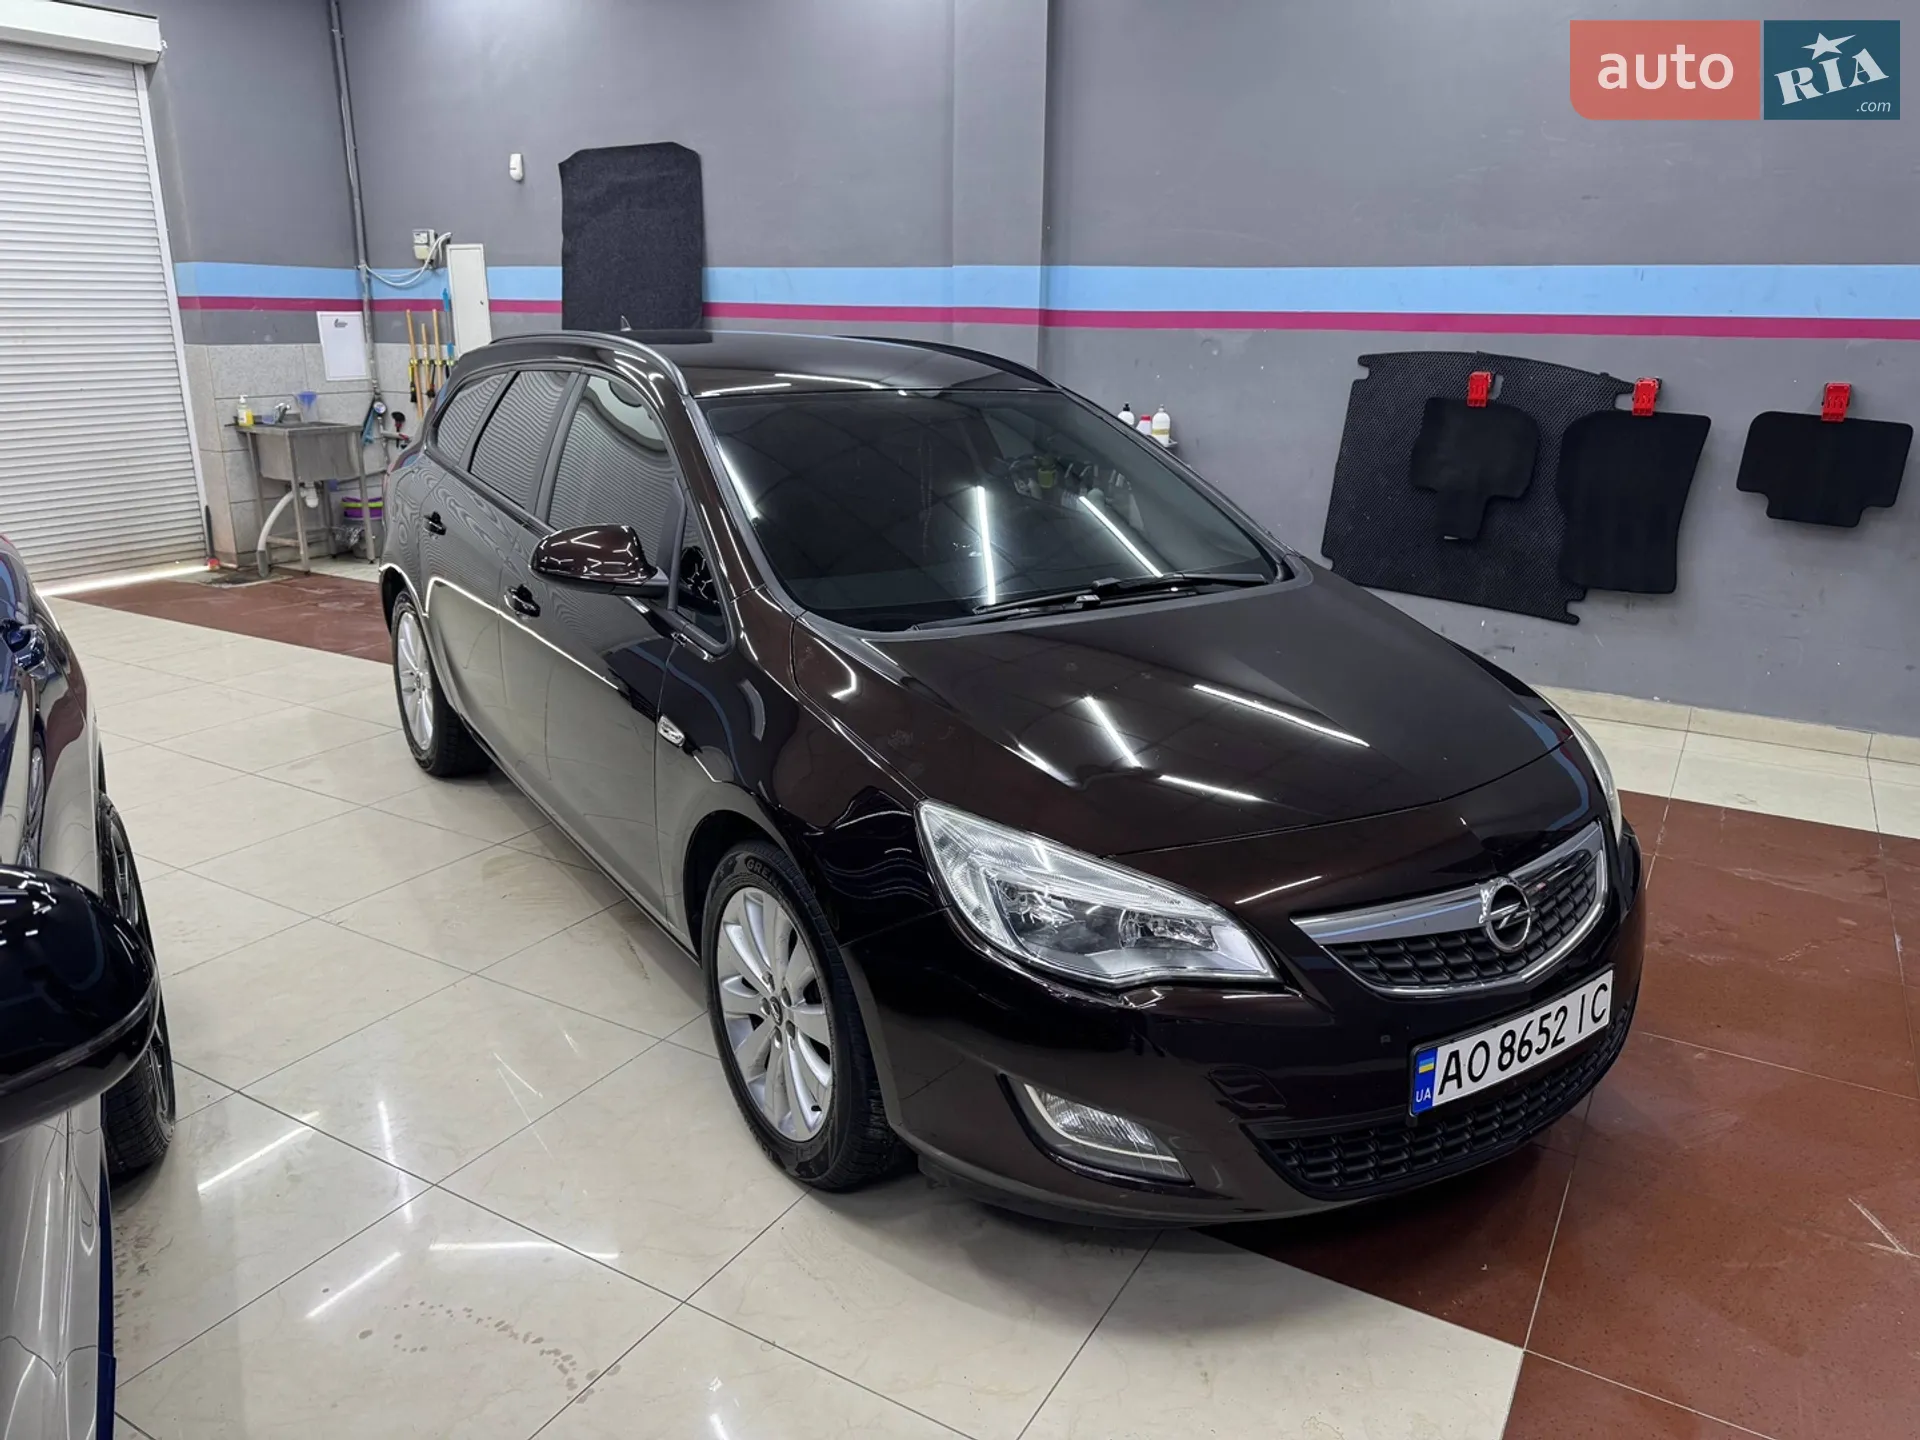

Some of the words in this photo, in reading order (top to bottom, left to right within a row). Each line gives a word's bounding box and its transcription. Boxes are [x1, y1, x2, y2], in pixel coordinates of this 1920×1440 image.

[1437, 1040, 1491, 1096] AO
[1497, 1005, 1569, 1072] 8652
[1577, 982, 1608, 1035] IC
[1415, 1087, 1432, 1103] UA
